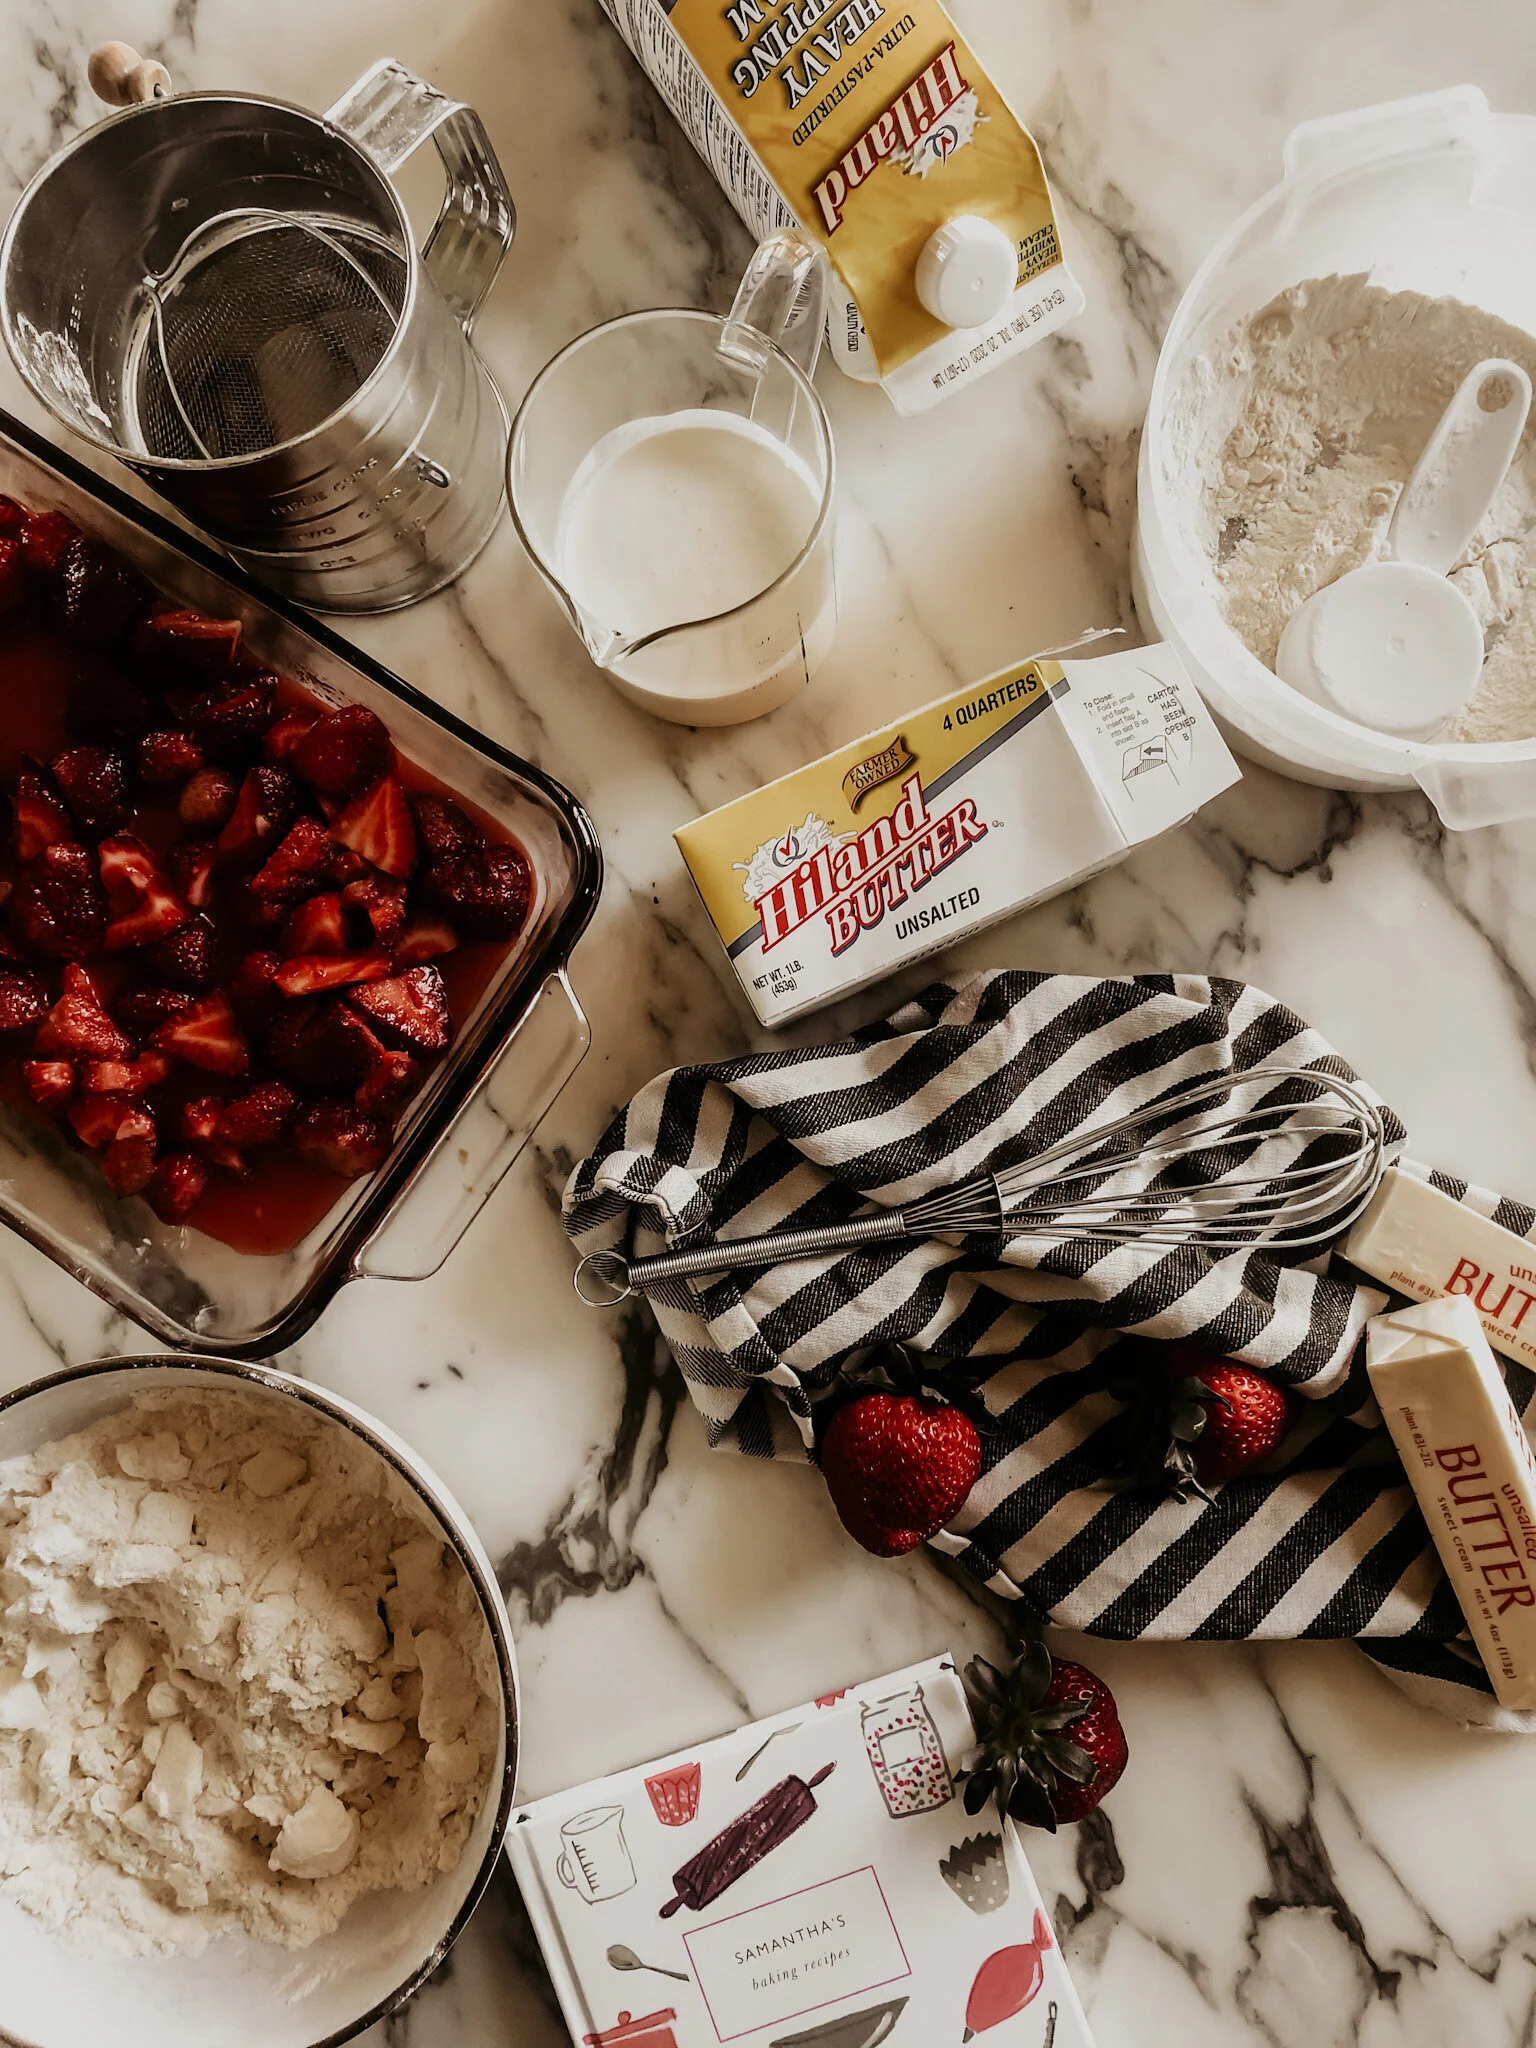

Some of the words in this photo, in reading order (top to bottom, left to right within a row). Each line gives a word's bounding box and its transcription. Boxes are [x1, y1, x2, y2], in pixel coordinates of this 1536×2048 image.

[781, 0, 885, 109] HEAVY
[792, 14, 916, 146] ULTRA-PASTEURIZED
[813, 40, 968, 237] Hiland
[1017, 235, 1055, 264] WHIPPI
[1019, 224, 1053, 250] CREAM
[1016, 254, 1058, 285] ULTRA-PAST
[1026, 244, 1057, 270] HEAVY
[845, 303, 858, 330] QUALITY
[943, 715, 952, 731] 4
[956, 674, 1037, 725] QUARTERS
[1093, 693, 1115, 705] Close:
[1097, 702, 1111, 713] Fold
[1147, 684, 1179, 703] CARTON
[1160, 699, 1177, 711] HAS
[1164, 709, 1186, 723] BEEN
[1164, 716, 1196, 735] OPENED
[1182, 733, 1189, 741] B
[850, 748, 898, 784] FARMER
[856, 759, 900, 788] OWNED
[754, 770, 931, 955] Hiland
[825, 798, 988, 958] BUTTER
[895, 887, 980, 940] UNSALTED
[752, 974, 769, 990] NET
[769, 968, 786, 982] WT.
[771, 977, 797, 998] (453g)
[1390, 1270, 1415, 1288] plant
[1444, 1257, 1536, 1330] BUT
[1481, 1319, 1517, 1344] sweet
[1520, 1341, 1536, 1357] cre
[1399, 1407, 1417, 1430] plant
[1412, 1432, 1434, 1468] #31-212
[1434, 1444, 1535, 1616] BUTTER
[1438, 1496, 1458, 1532] sweet
[1453, 1536, 1473, 1572] cream
[1474, 1588, 1487, 1604] net
[1482, 1607, 1492, 1620] wt
[1489, 1624, 1501, 1642] 4oz
[1497, 1646, 1517, 1679] (113g)
[735, 1914, 845, 1964] SAMANTHA'S
[752, 1967, 798, 1990] baking
[804, 1948, 850, 1972] recipes
